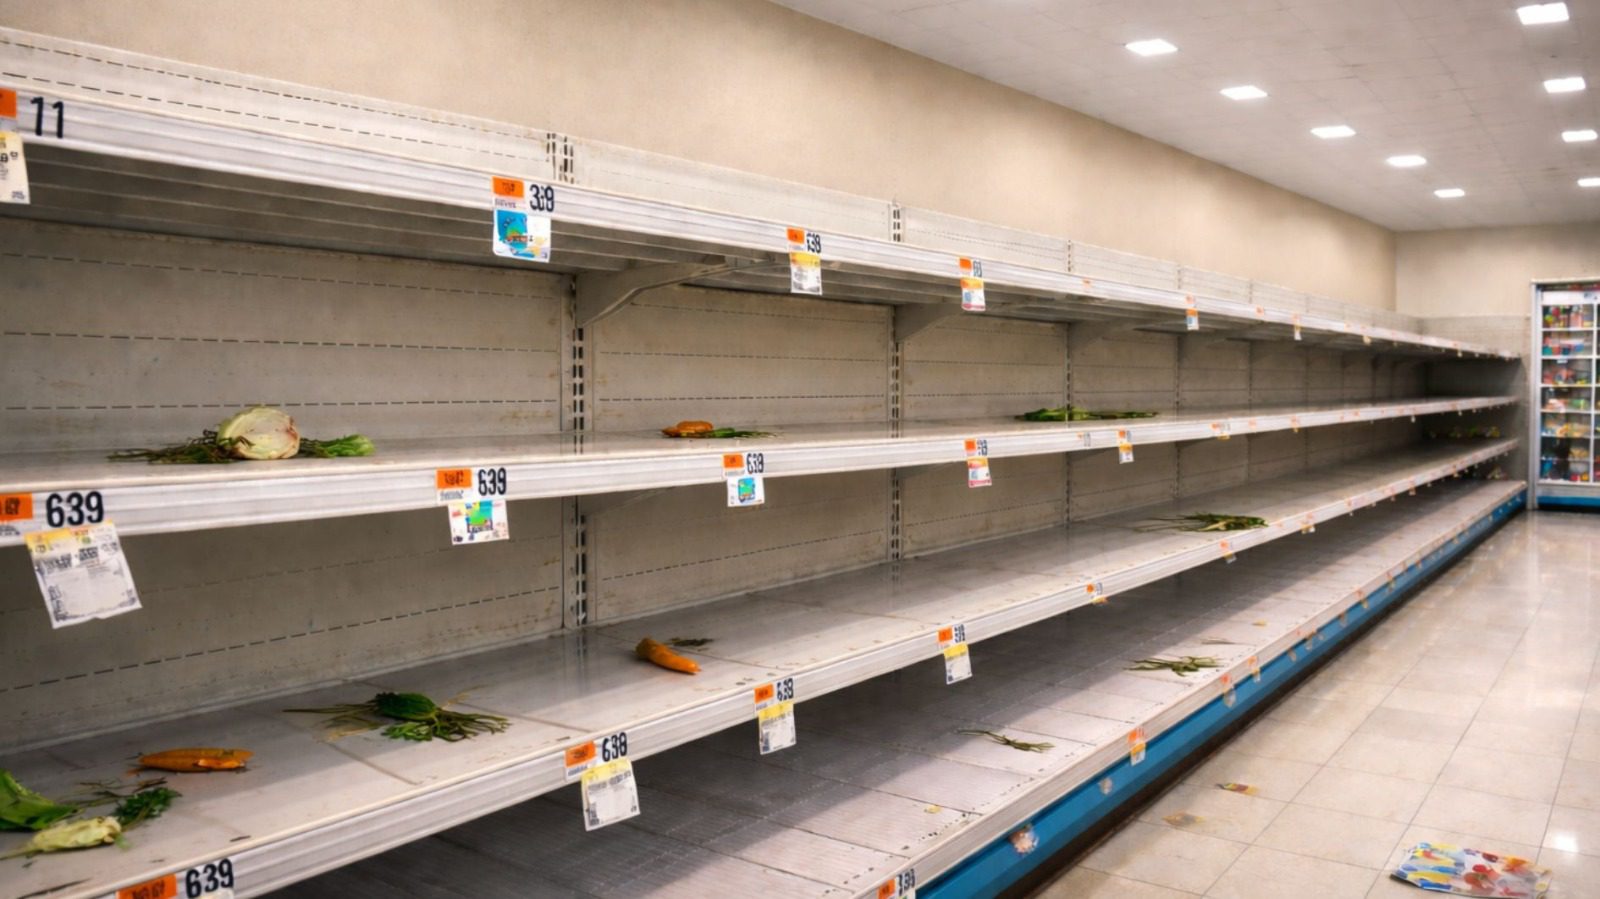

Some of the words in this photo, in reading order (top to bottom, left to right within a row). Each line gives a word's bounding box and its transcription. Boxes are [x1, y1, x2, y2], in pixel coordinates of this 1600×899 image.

[478, 467, 507, 496] 639
[46, 491, 104, 528] 639
[185, 858, 235, 899] 639
